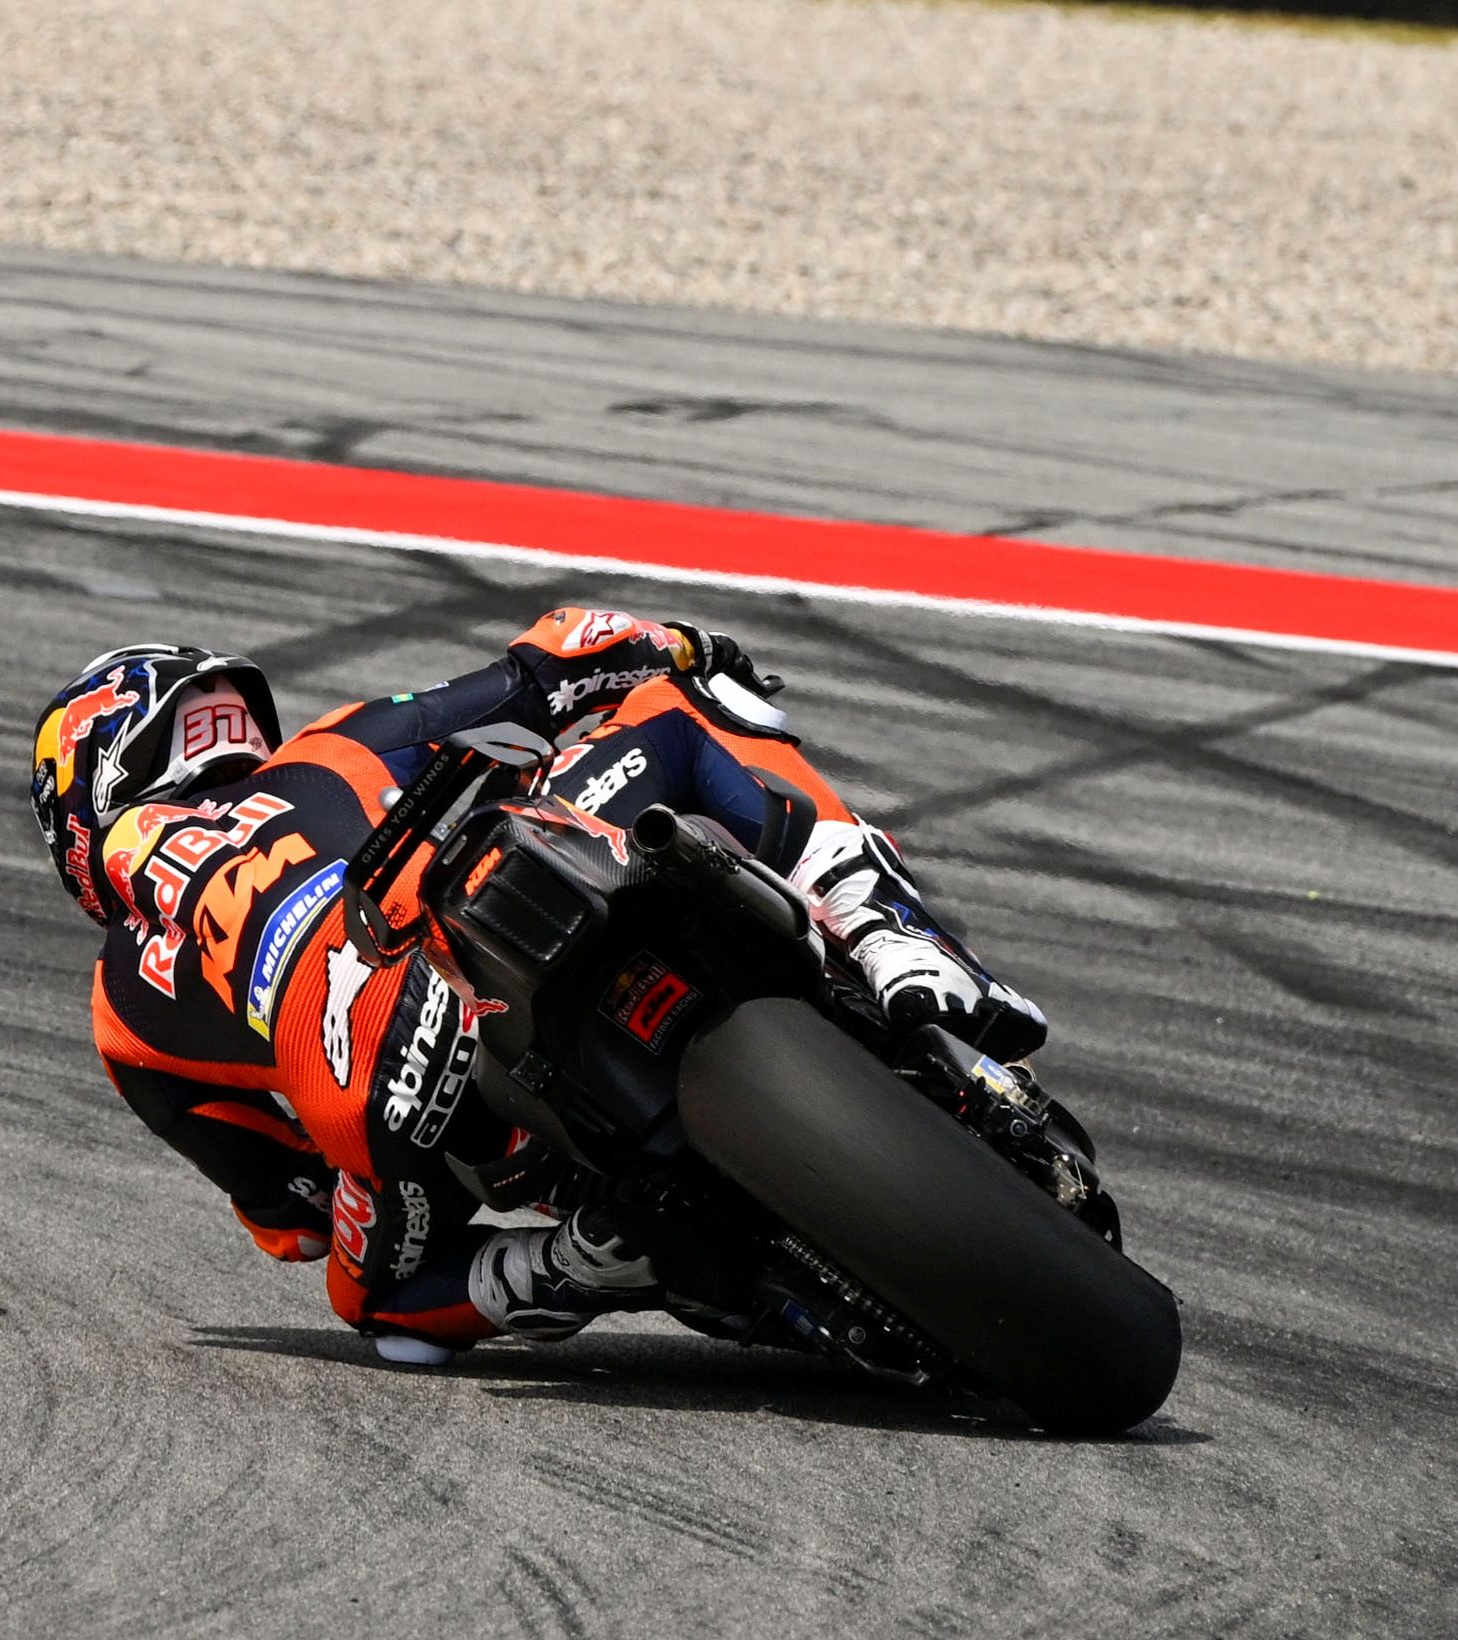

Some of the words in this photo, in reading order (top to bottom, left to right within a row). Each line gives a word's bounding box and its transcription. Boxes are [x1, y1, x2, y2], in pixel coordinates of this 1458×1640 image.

[183, 703, 249, 761] 37
[361, 827, 392, 864] GIVES
[391, 801, 415, 825] YOU
[413, 752, 450, 797] WINGS
[192, 832, 318, 1015] KTM
[261, 871, 341, 983] MICHELIN
